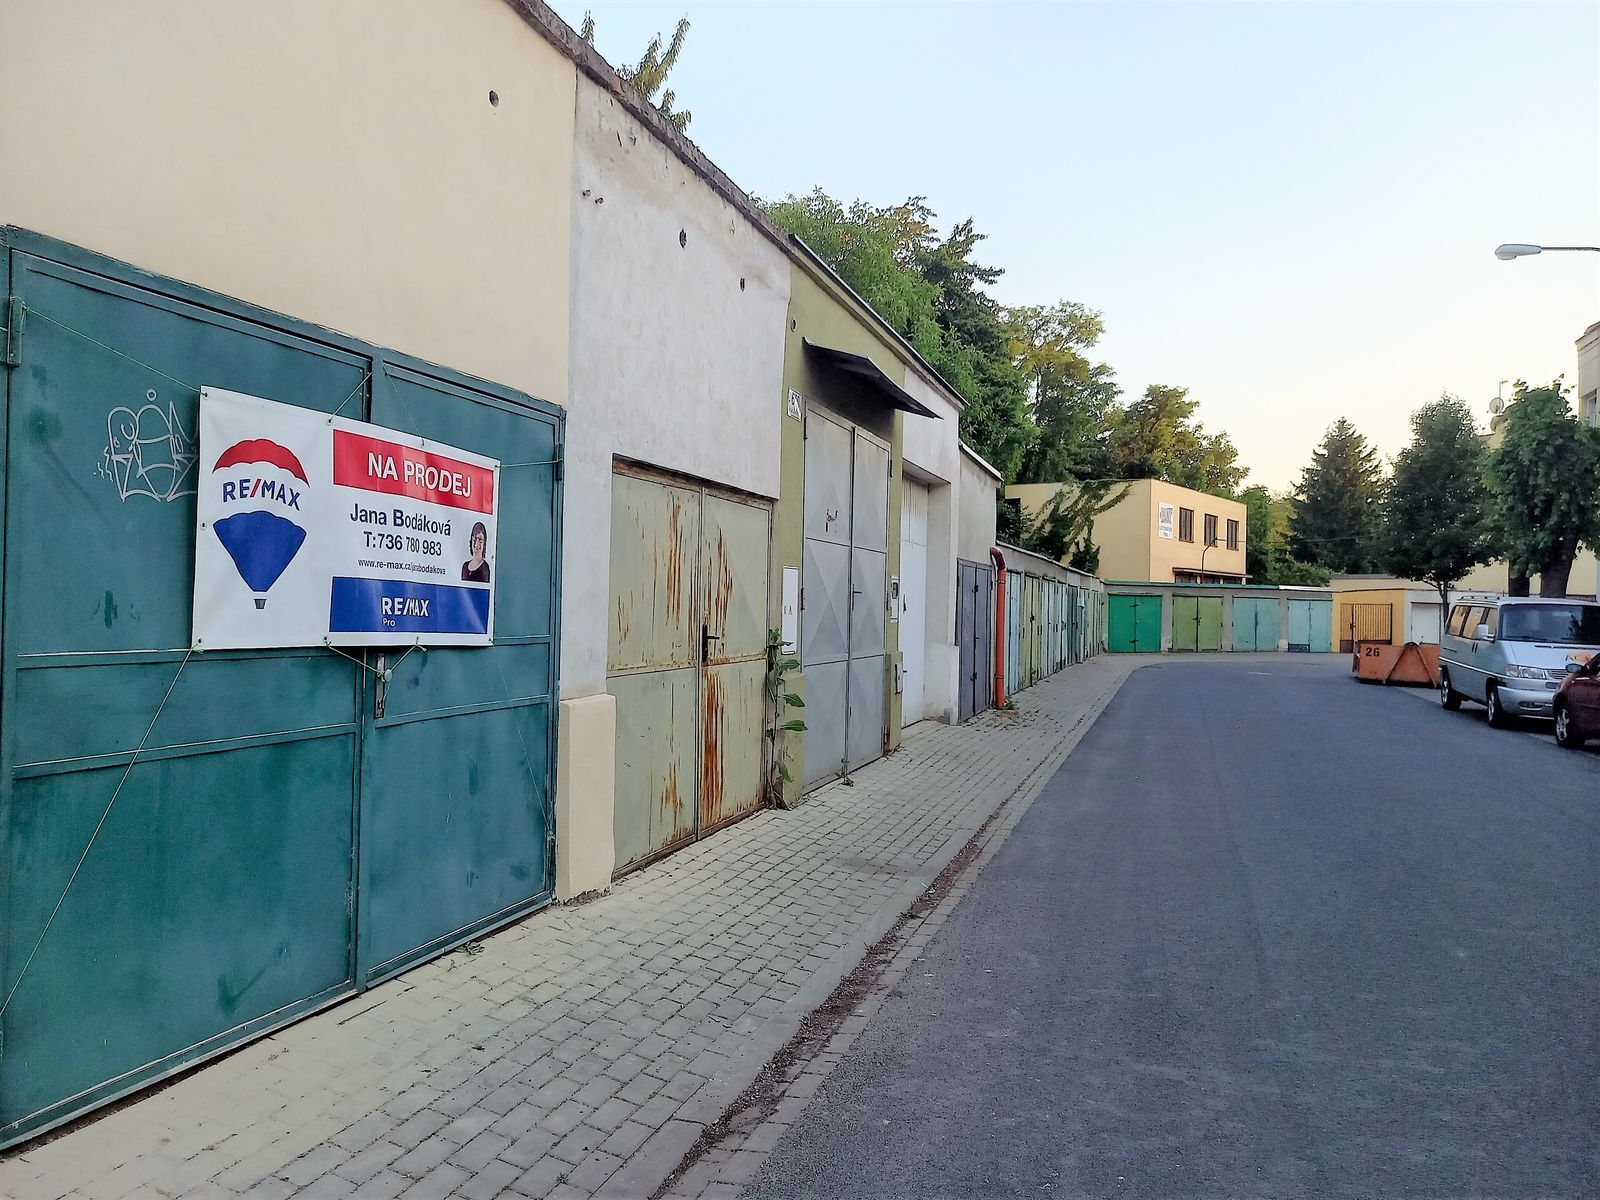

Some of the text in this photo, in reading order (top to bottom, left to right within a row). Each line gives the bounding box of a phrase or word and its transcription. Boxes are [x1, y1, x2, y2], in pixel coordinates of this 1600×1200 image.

[368, 452, 471, 497] NA PRODEJ
[222, 478, 301, 511] RE/MAX
[350, 503, 451, 536] Jana Bodáková
[363, 530, 442, 556] T:736 780 983
[357, 559, 446, 575] www.re-max.cz/jbodakova
[381, 597, 430, 617] RE/MAX
[382, 617, 396, 627] Pro
[1365, 646, 1380, 657] 26
